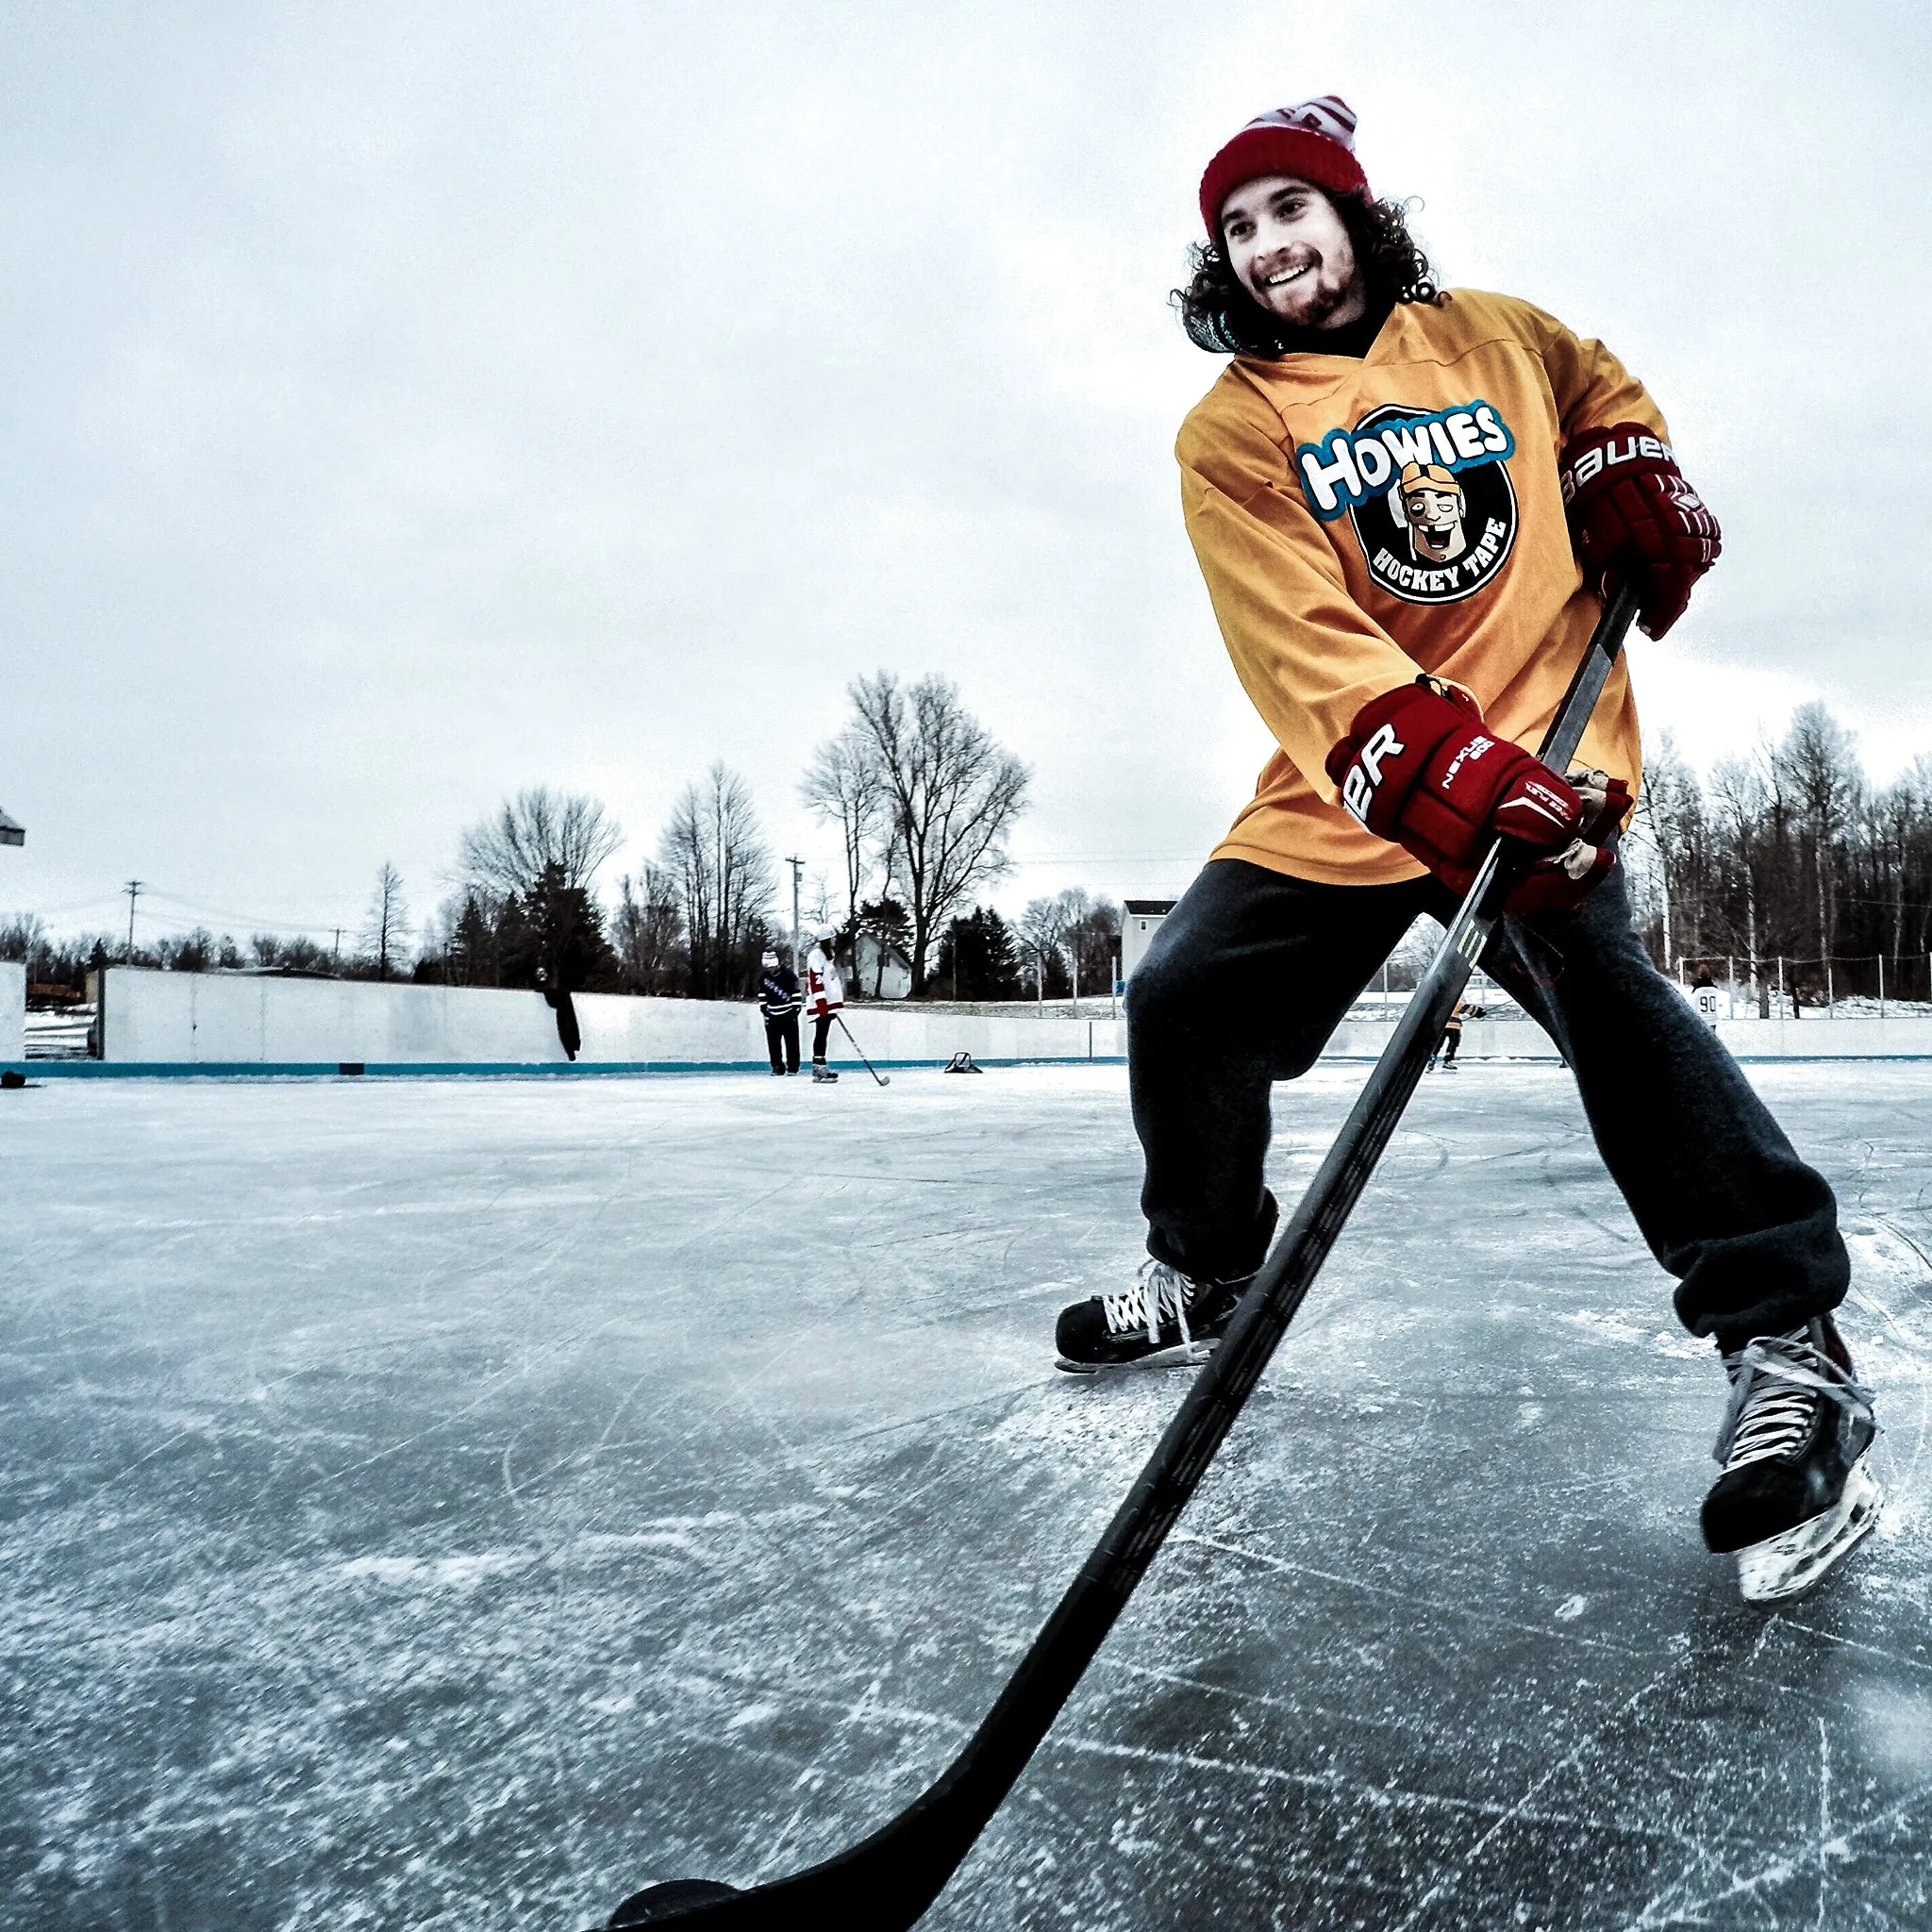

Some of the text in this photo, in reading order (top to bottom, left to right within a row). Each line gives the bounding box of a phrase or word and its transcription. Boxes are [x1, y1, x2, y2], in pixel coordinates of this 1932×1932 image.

[1301, 407, 1507, 510] HOWIES
[1373, 517, 1507, 592] HOCKEY TAPE
[1441, 735, 1488, 790] NEXUS
[1700, 995, 1717, 1012] 90
